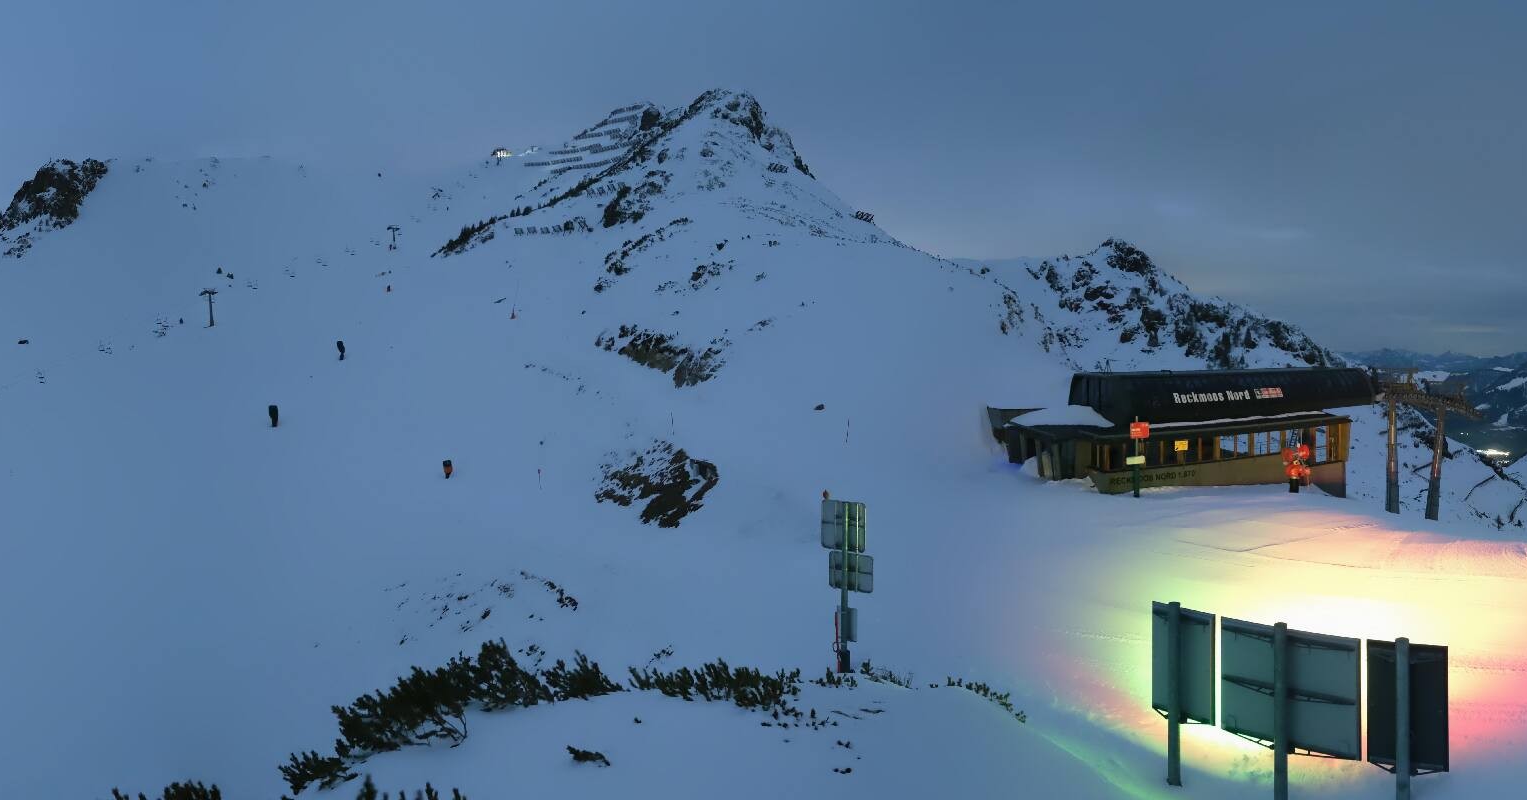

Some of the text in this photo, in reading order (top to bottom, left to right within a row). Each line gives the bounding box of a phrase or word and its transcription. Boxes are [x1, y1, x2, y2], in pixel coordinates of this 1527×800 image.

[1173, 391, 1224, 404] Reckmoos
[1226, 390, 1250, 402] Nord
[1110, 474, 1154, 485] RECKOOS
